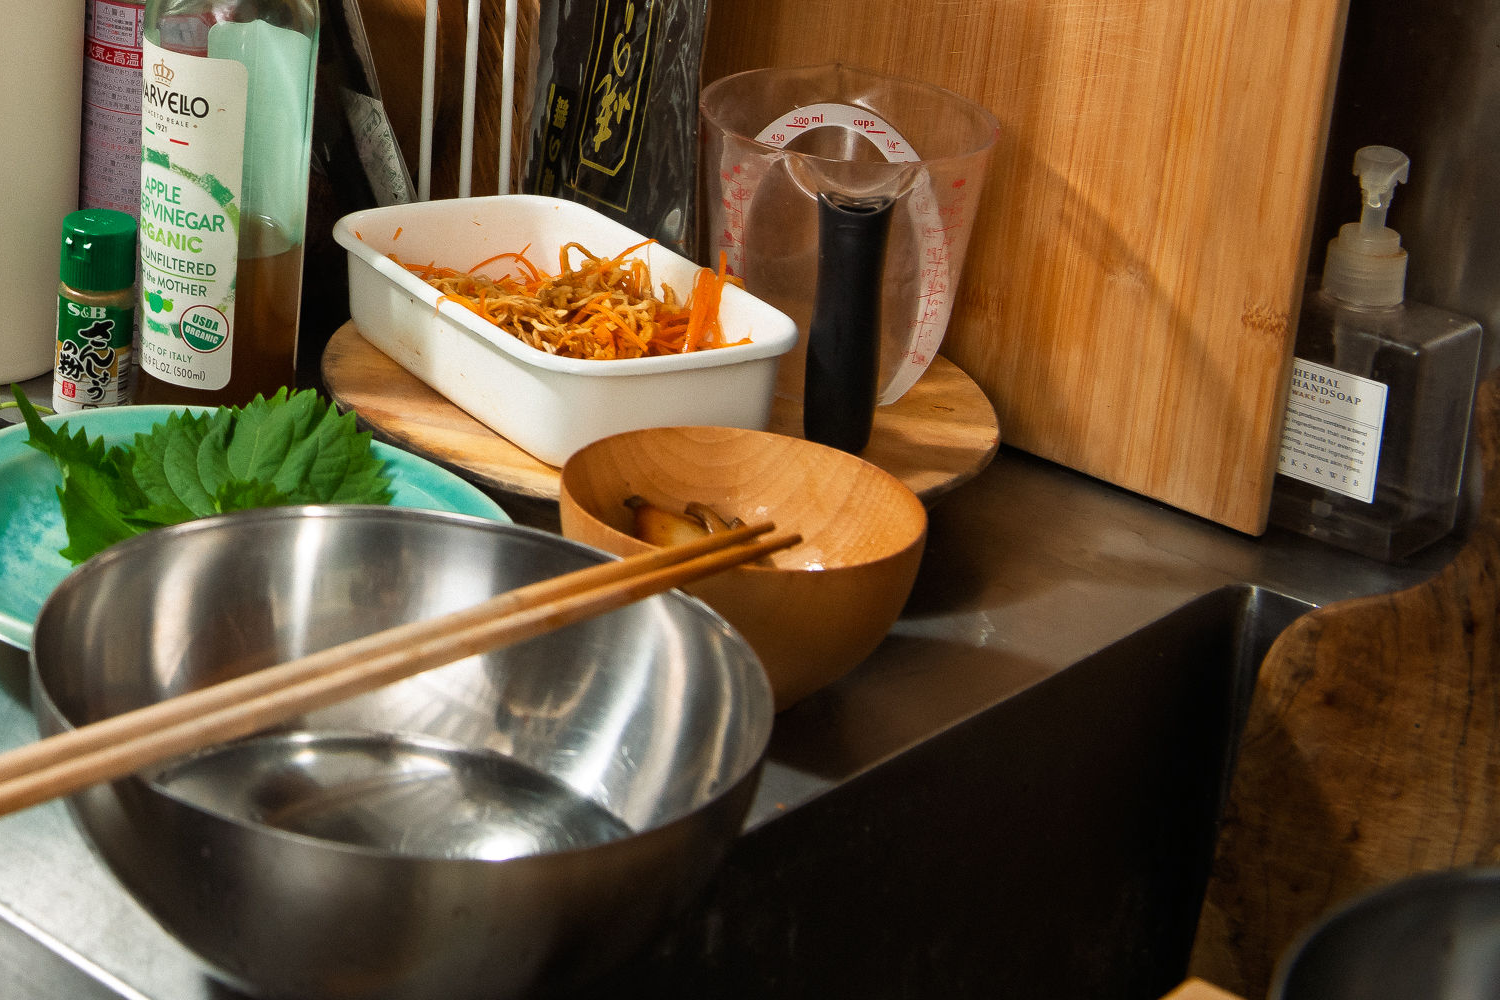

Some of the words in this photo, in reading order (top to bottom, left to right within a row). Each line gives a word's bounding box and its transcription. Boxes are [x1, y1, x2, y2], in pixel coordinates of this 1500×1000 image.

[87, 44, 143, 67] 火気と高温
[155, 122, 168, 133] 1921
[167, 117, 189, 128] REALE
[793, 116, 810, 126] 500
[812, 113, 824, 124] ml
[853, 118, 875, 129] cups
[771, 133, 785, 142] 450
[145, 175, 181, 205] APPLE
[152, 200, 225, 232] VINEGAR
[141, 216, 203, 253] RGANIC
[145, 245, 217, 277] UNFILTERED
[157, 276, 207, 298] MOTHER
[67, 302, 106, 319] S&B
[192, 313, 219, 331] USDA
[185, 325, 219, 344] ORGANIC
[58, 340, 85, 380] の粉
[78, 320, 116, 403] さんしょう
[156, 346, 167, 356] OF
[169, 351, 193, 363] ITALY
[173, 366, 206, 381] (500ml)
[1293, 367, 1340, 389] HERBAL
[1291, 389, 1316, 402] WAKE
[1319, 397, 1331, 405] UP
[1292, 378, 1362, 405] HANDSOAP
